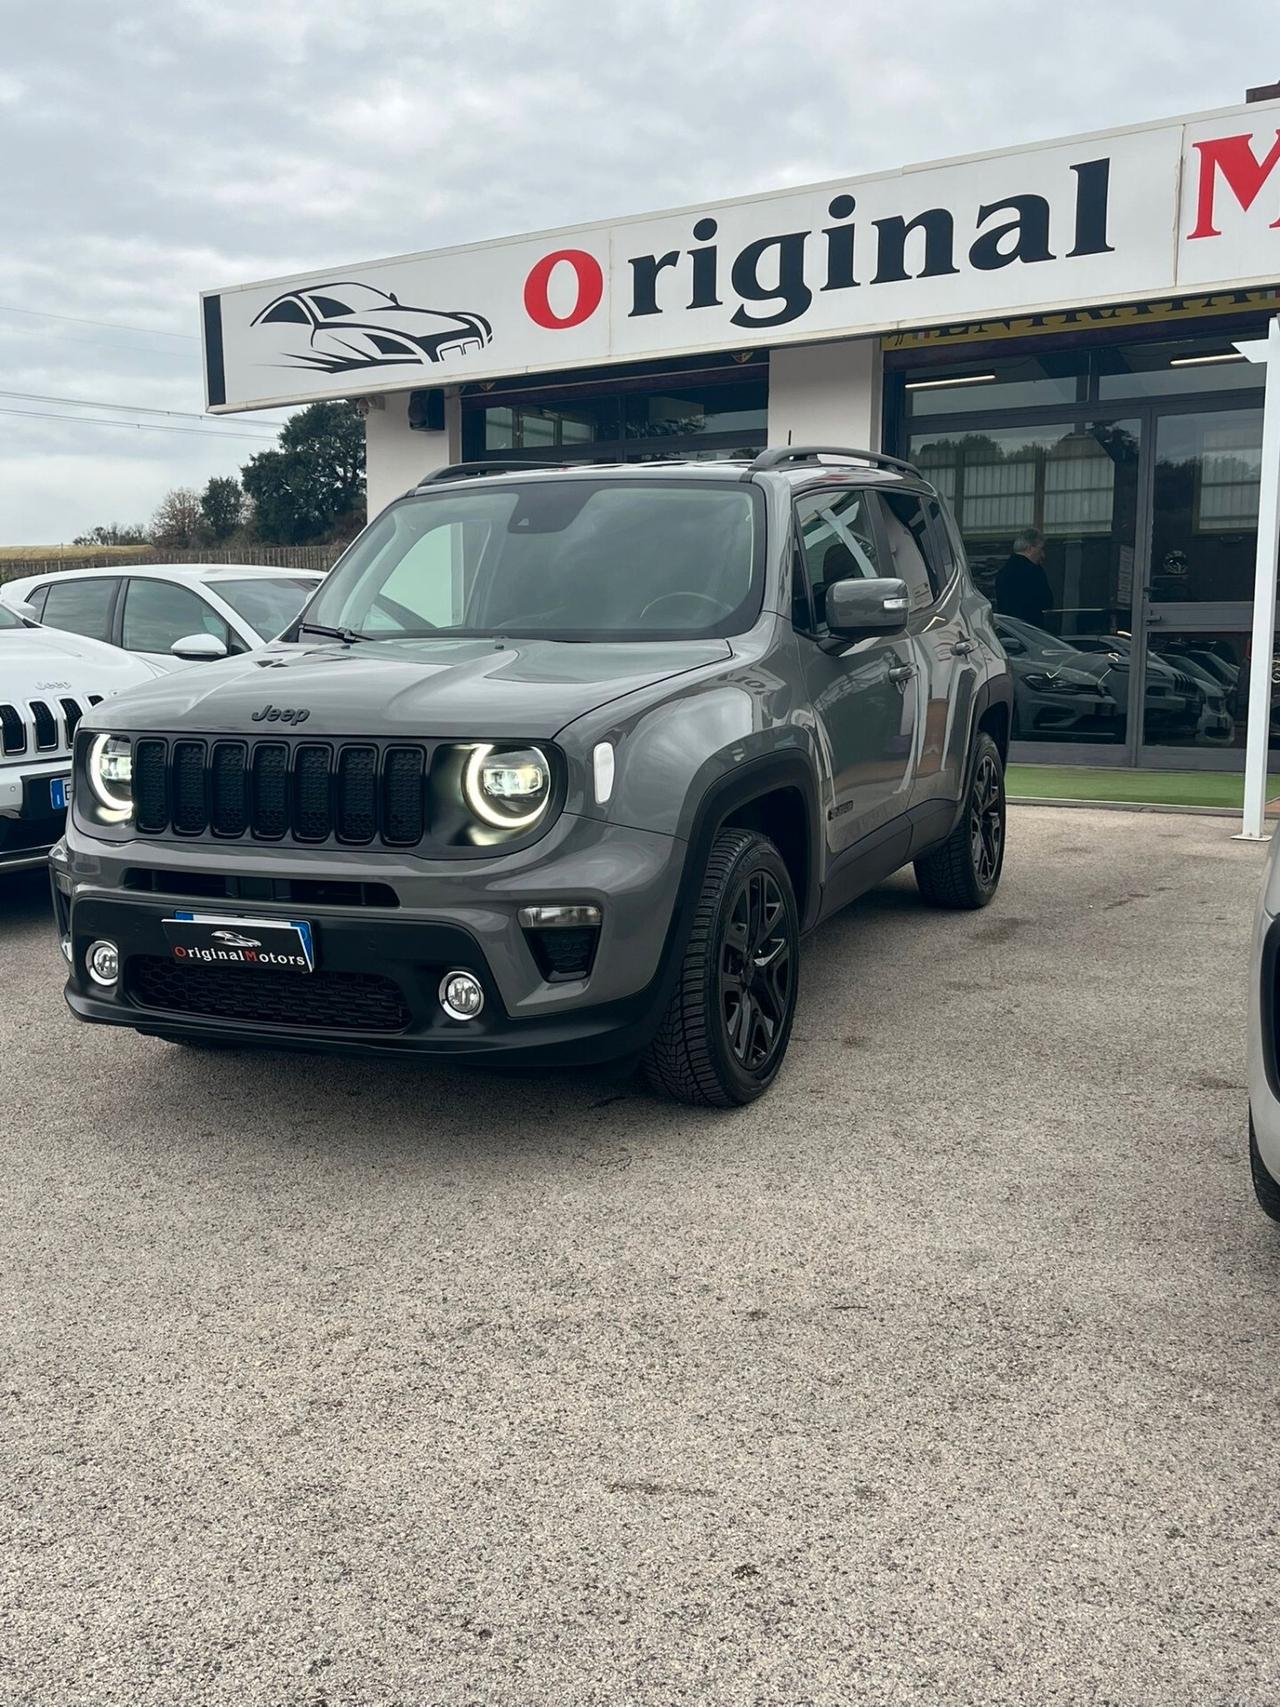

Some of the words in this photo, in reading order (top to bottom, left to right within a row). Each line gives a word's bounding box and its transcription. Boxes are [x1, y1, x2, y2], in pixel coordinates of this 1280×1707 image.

[523, 157, 1115, 330] Original
[251, 704, 310, 726] Jeep
[174, 946, 306, 966] OriginalMotors
